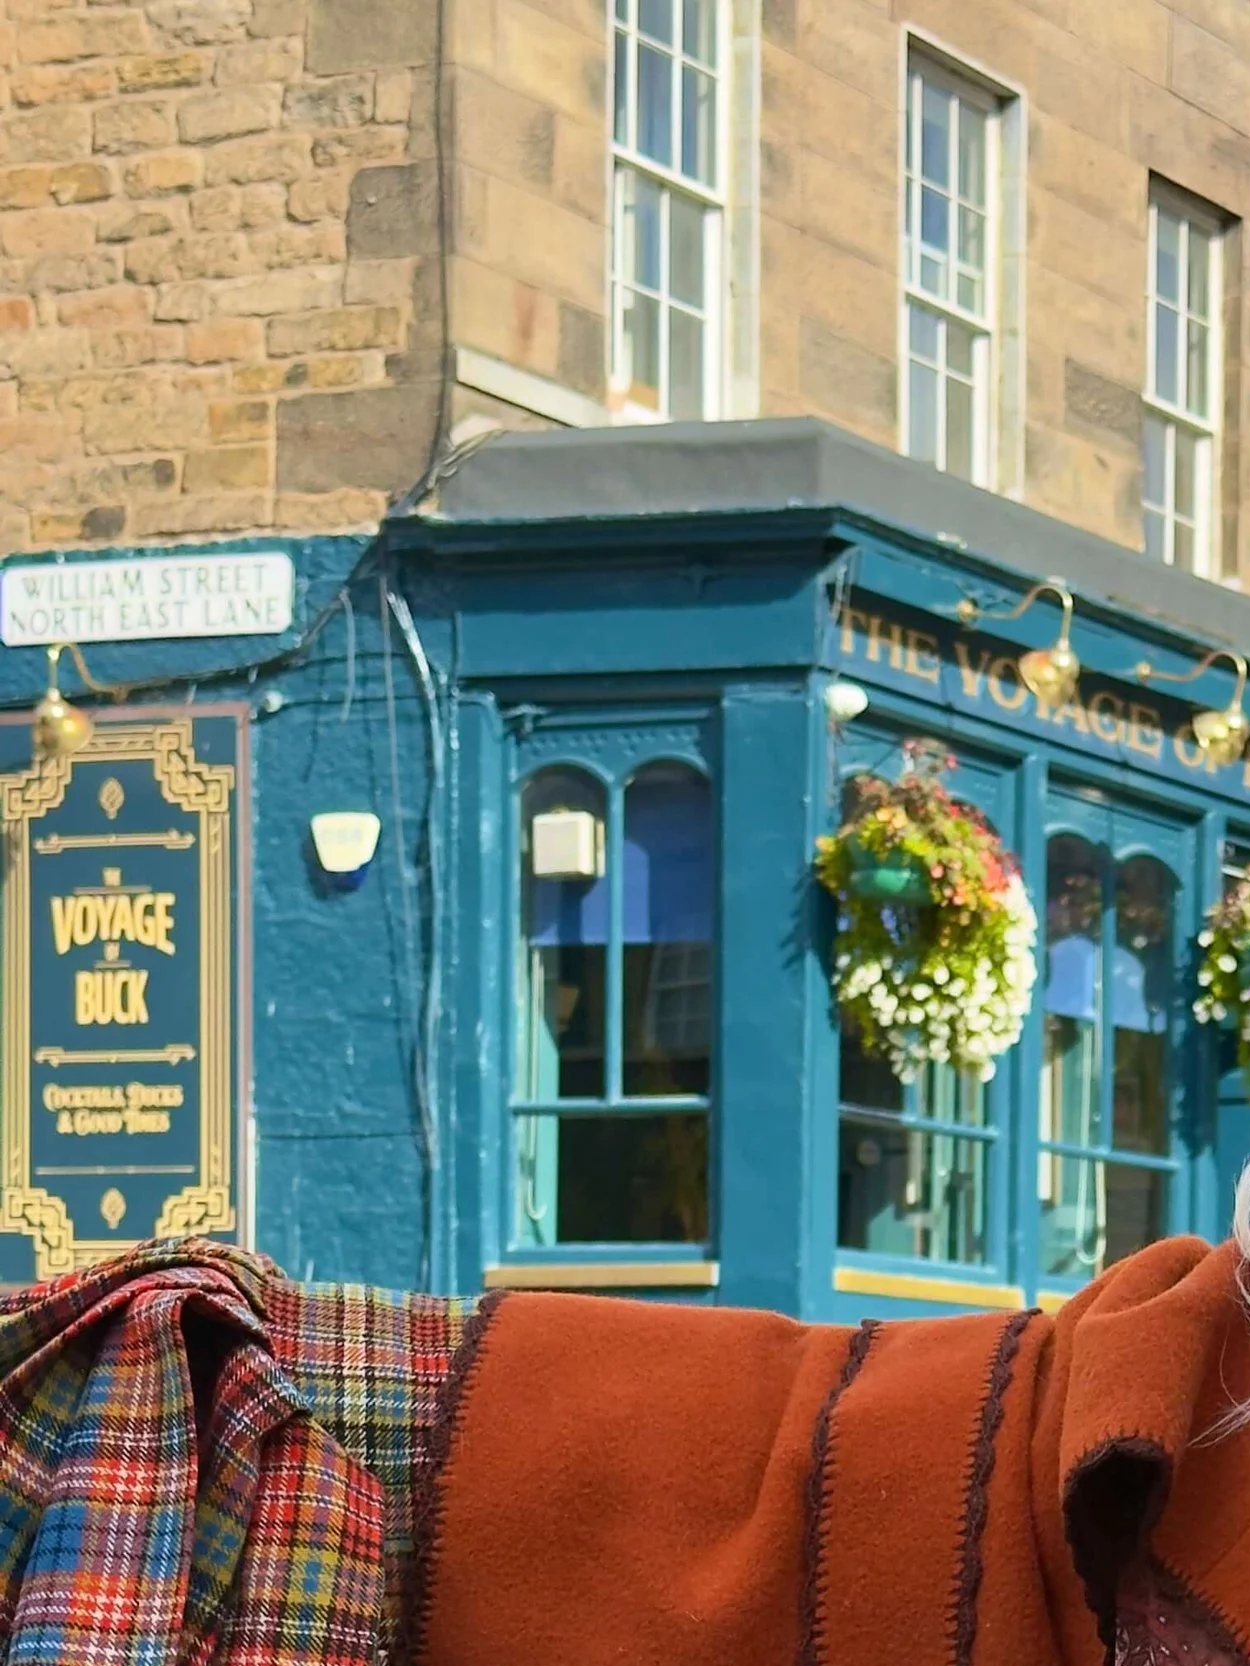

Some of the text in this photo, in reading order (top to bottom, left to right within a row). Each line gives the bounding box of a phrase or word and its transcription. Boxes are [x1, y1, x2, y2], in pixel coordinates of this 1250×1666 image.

[22, 564, 267, 602] WILLIAM STREET
[10, 597, 279, 636] NORTH EAST LANE
[840, 606, 941, 684] THE
[955, 641, 1163, 758] VOAGE
[51, 893, 176, 956] VOYAGE
[75, 969, 149, 1025] BUCK
